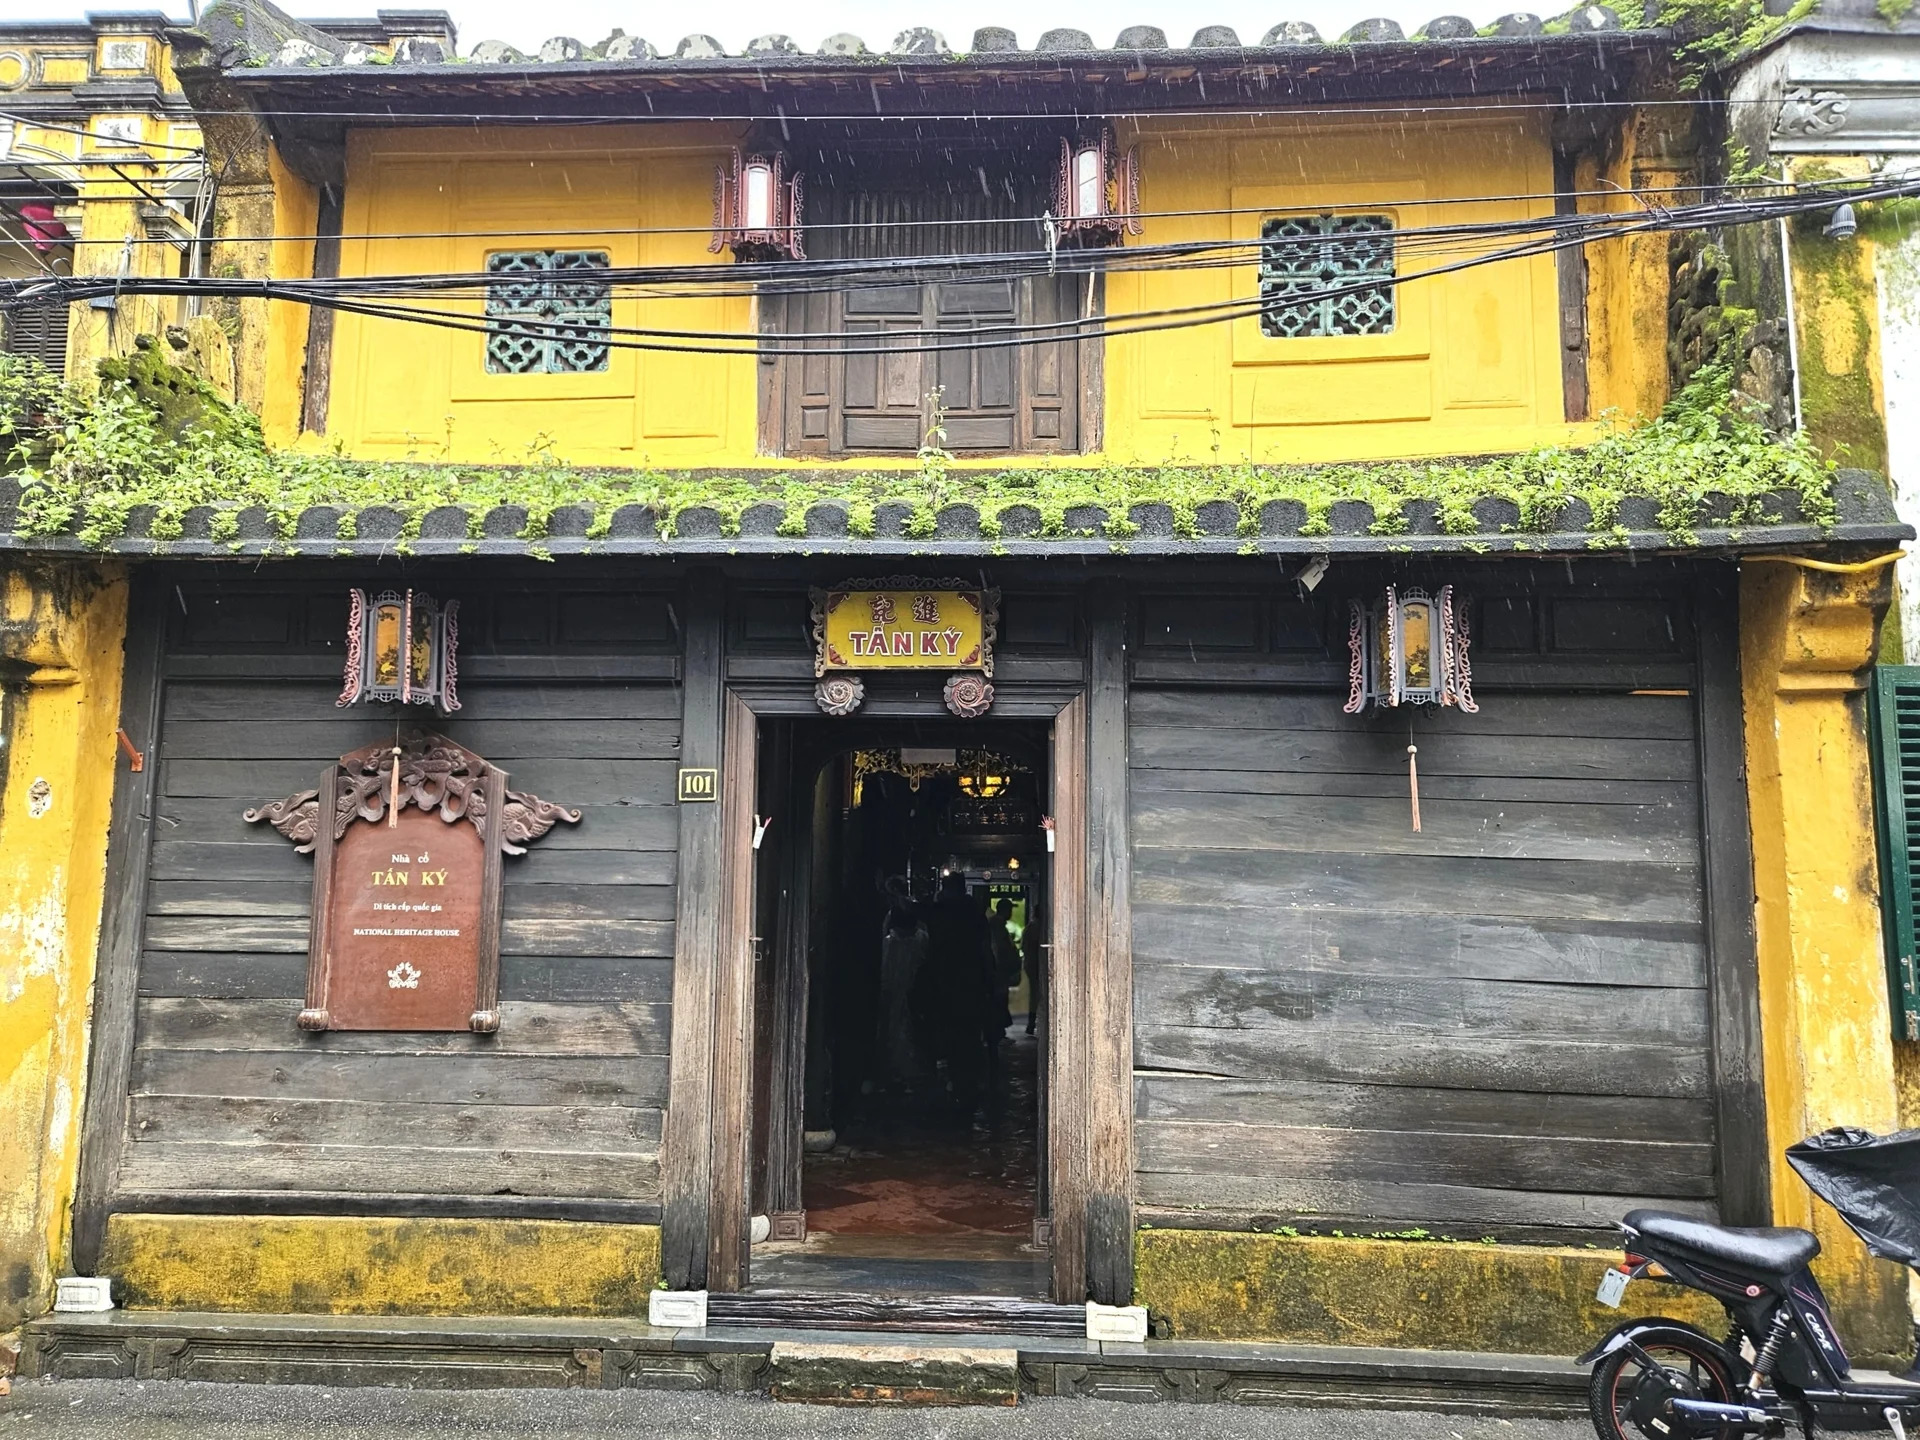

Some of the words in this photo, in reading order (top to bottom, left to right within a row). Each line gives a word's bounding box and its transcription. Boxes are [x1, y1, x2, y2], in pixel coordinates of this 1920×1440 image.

[920, 626, 963, 656] KÝ
[685, 775, 711, 794] 101
[391, 854, 410, 863] Nhà
[417, 851, 430, 863] cổ
[371, 867, 409, 886] TẤN
[421, 867, 449, 886] KÝ
[430, 903, 443, 913] gia
[353, 928, 393, 936] NATIONAL
[394, 929, 433, 937] HERITAGE
[434, 929, 460, 937] HOUSE
